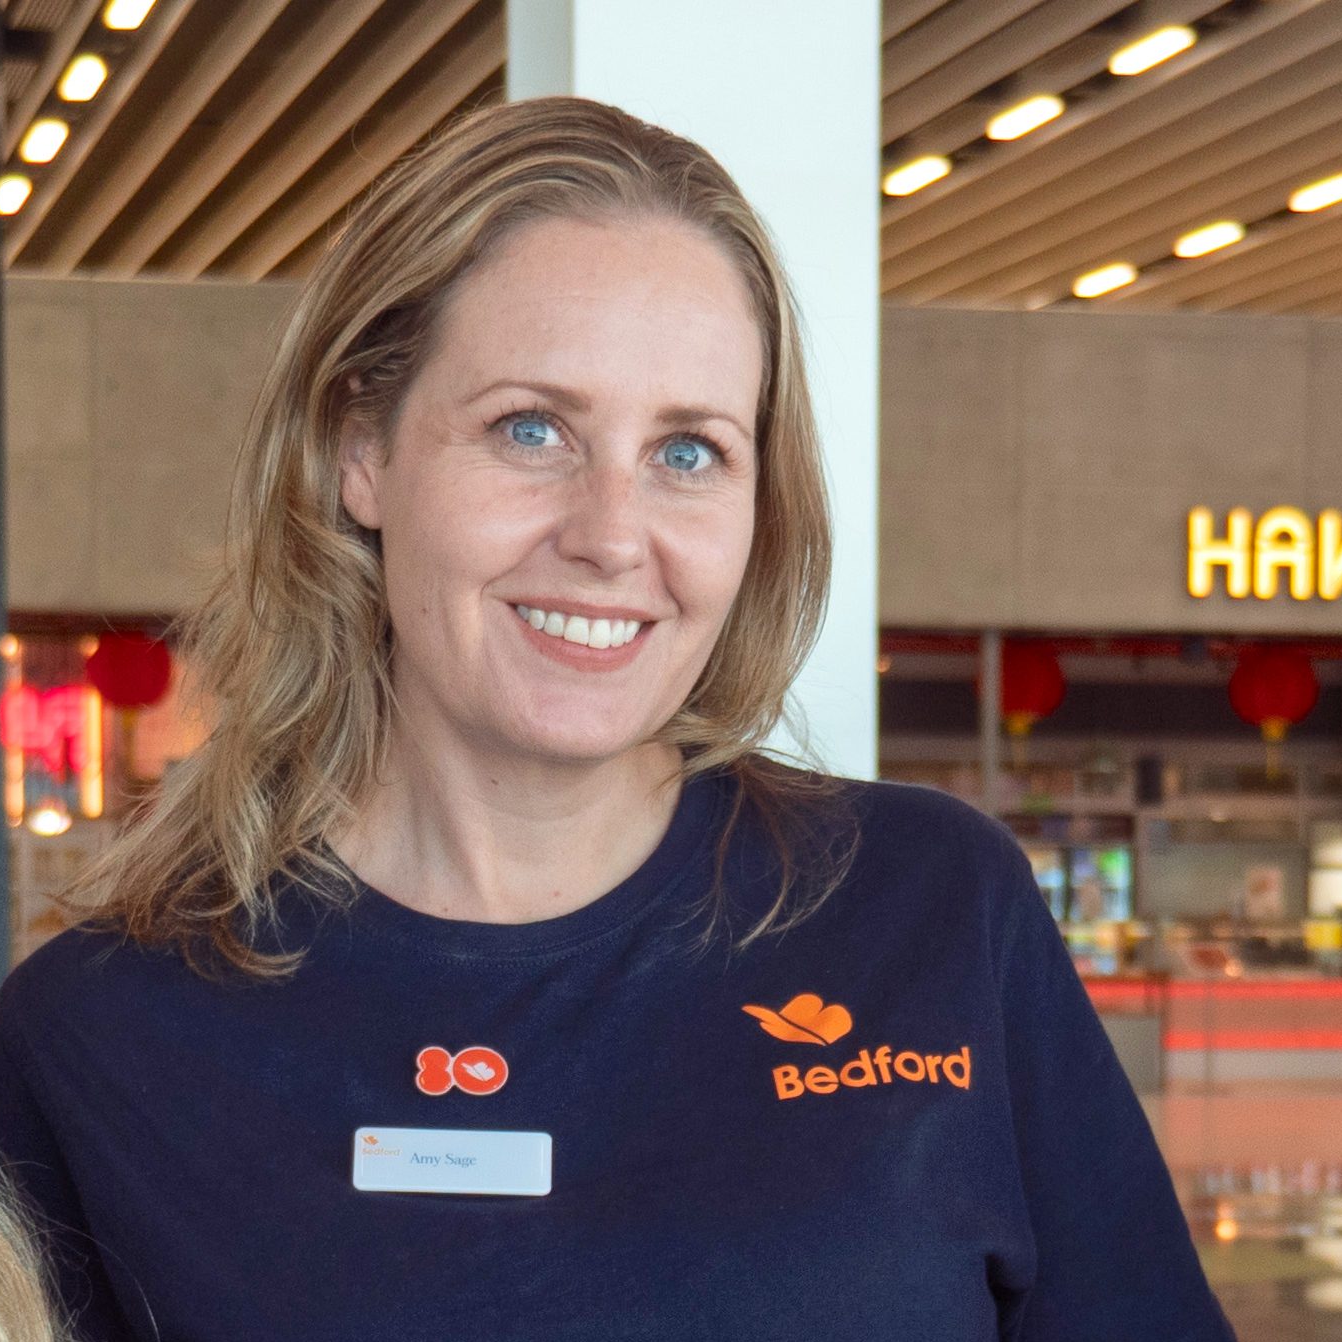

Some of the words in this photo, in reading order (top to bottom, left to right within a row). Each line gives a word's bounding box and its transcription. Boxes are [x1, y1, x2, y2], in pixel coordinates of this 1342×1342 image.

[772, 1045, 972, 1100] Bedford
[410, 1152, 441, 1167] Amy
[445, 1153, 478, 1168] Sage
